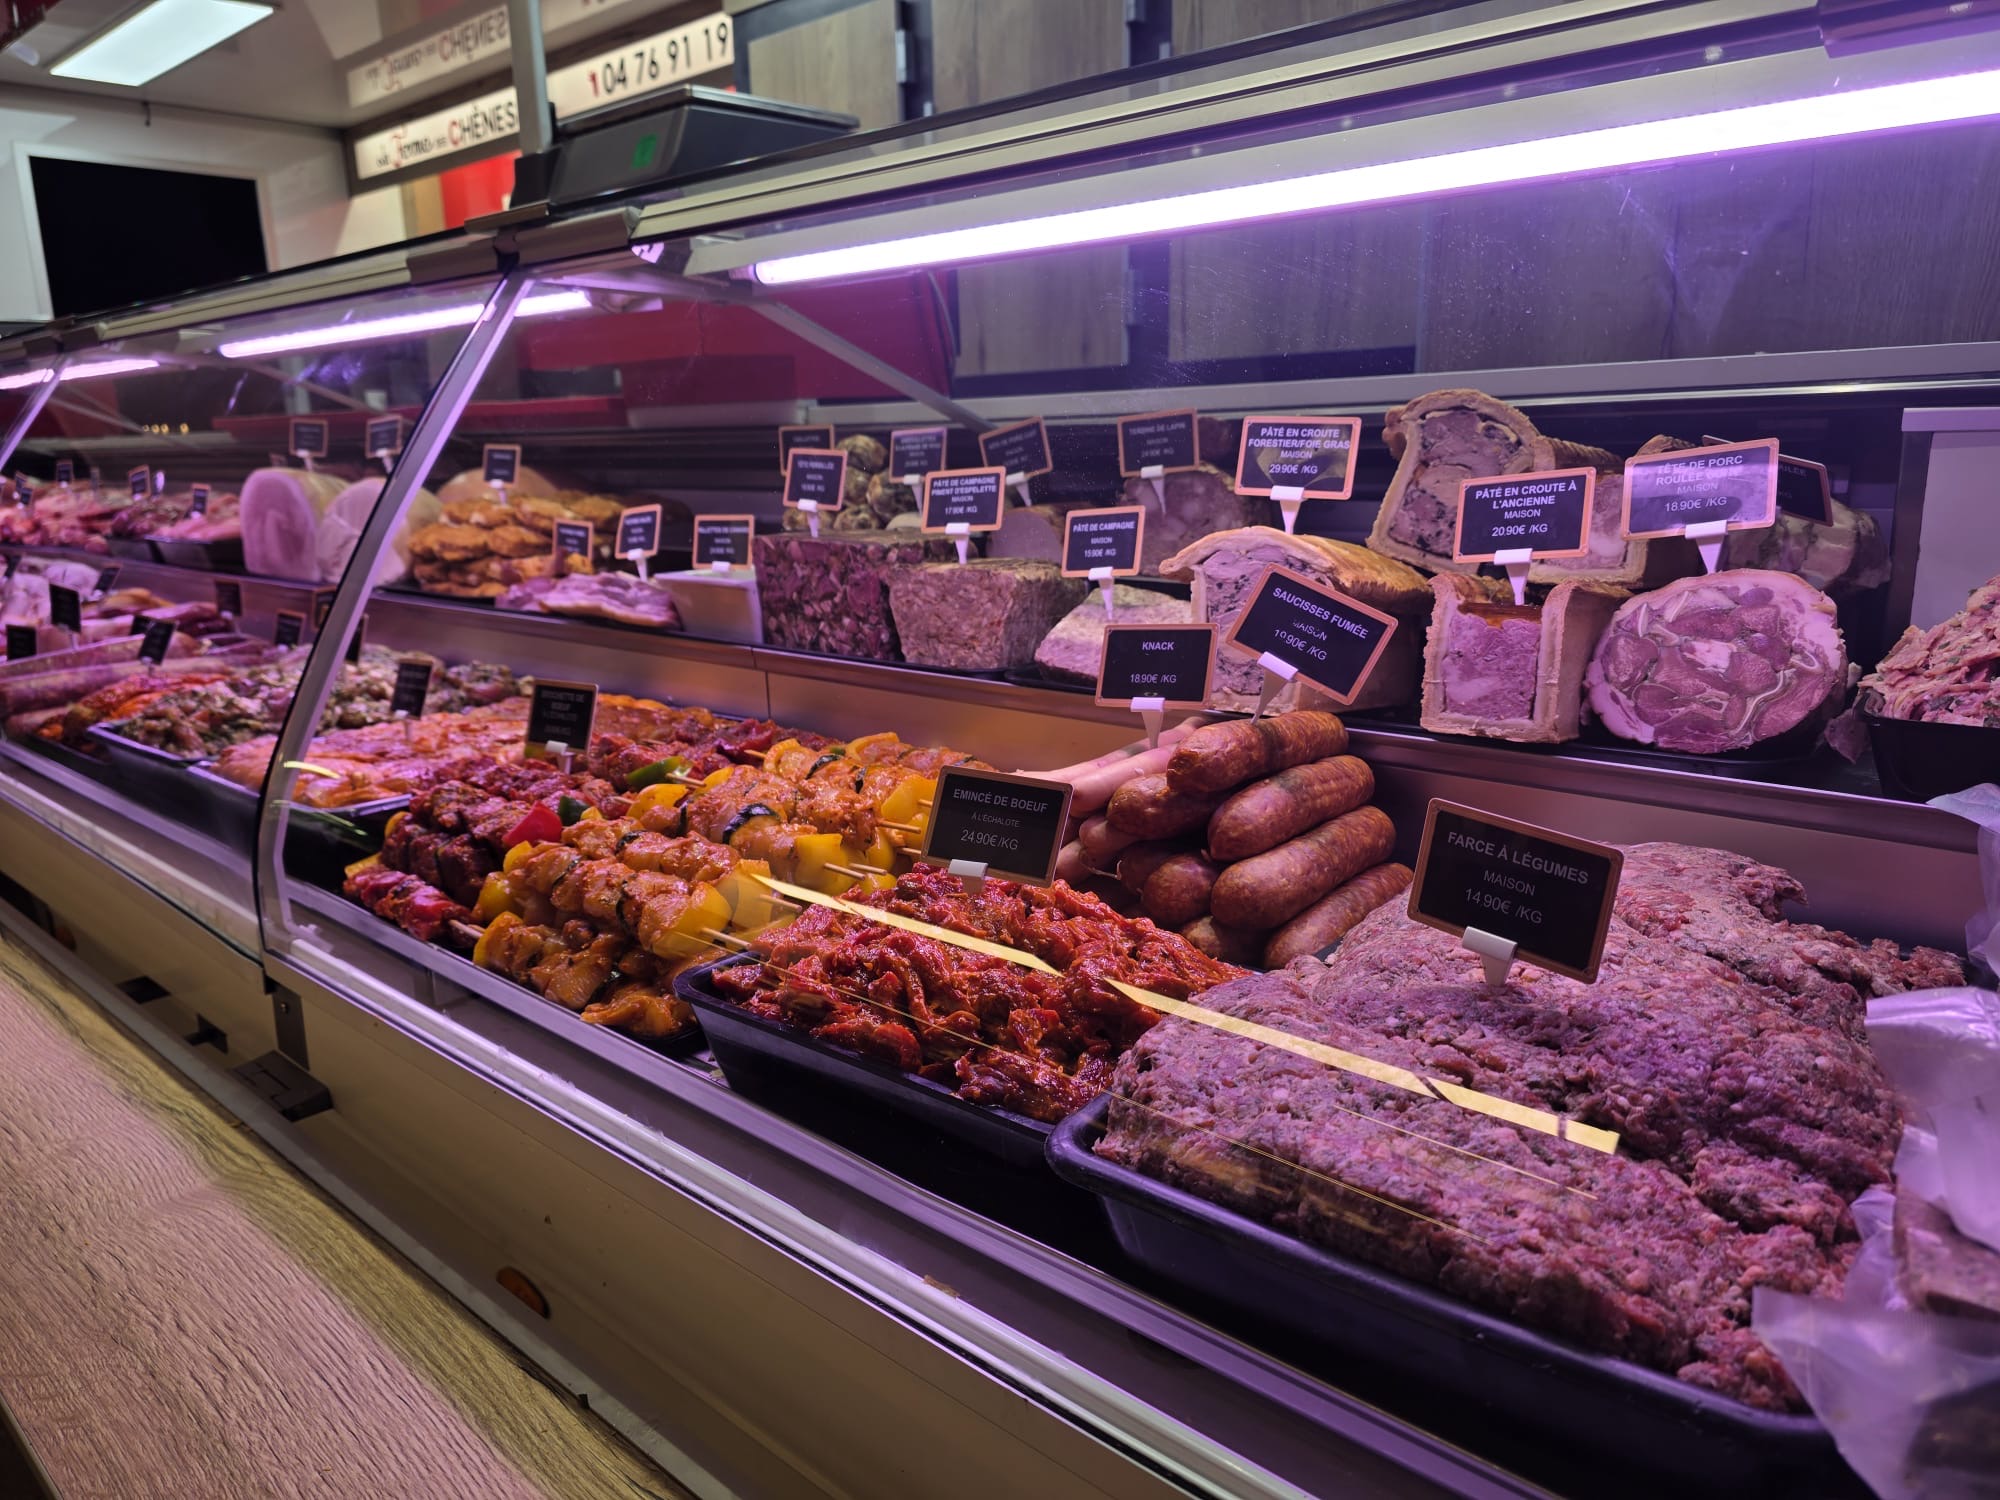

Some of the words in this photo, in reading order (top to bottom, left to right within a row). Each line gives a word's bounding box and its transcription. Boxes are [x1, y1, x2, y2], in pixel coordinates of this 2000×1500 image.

[602, 58, 628, 95] 04
[635, 48, 660, 81] 76
[667, 36, 691, 73] 91
[705, 22, 729, 61] 19
[1260, 427, 1284, 438] PÂTÉ
[1286, 428, 1299, 437] EN
[1300, 428, 1340, 438] CROUTE
[1248, 438, 1321, 449] FORESTIER/FOIE
[1323, 440, 1351, 449] GRAS
[1280, 450, 1313, 459] MAISON
[1301, 464, 1318, 474] /KG
[1656, 462, 1686, 474] TÊTE
[1689, 459, 1705, 470] DE
[1708, 455, 1743, 468] PORC
[933, 478, 949, 488] PÂTÉ
[950, 479, 959, 487] DE
[960, 475, 996, 487] CAMPAGNE
[1677, 481, 1719, 494] MAISON
[1475, 487, 1502, 500] PÂTÉ
[1504, 487, 1519, 497] EN
[1521, 482, 1566, 495] CROUTE
[1568, 479, 1577, 491] À
[1492, 495, 1556, 509] L'ANCIENNE
[1665, 499, 1702, 512] 18.90€
[1705, 496, 1728, 507] /KG
[1504, 508, 1541, 519] MAISON
[1072, 522, 1089, 533] PÂTÉ
[1089, 523, 1098, 532] DE
[1099, 520, 1136, 531] CAMPAGNE
[1491, 524, 1526, 537] 20.90€
[1528, 523, 1548, 534] /KG
[1090, 536, 1113, 544] MAISON
[1272, 587, 1331, 620] SAUCISSES
[1331, 614, 1369, 639] FUMÉE
[1142, 641, 1175, 651] KNACK
[1307, 645, 1328, 661] /KG
[1160, 674, 1177, 683] /KG
[953, 788, 993, 804] EMINCÉ
[993, 795, 1009, 807] DE
[1010, 798, 1049, 813] BOEUF
[1447, 831, 1496, 857] FARCE
[1497, 844, 1508, 861] À
[1512, 851, 1590, 885] LÉGUMES
[1483, 869, 1536, 897] MAISON
[1514, 904, 1543, 924] /KG
